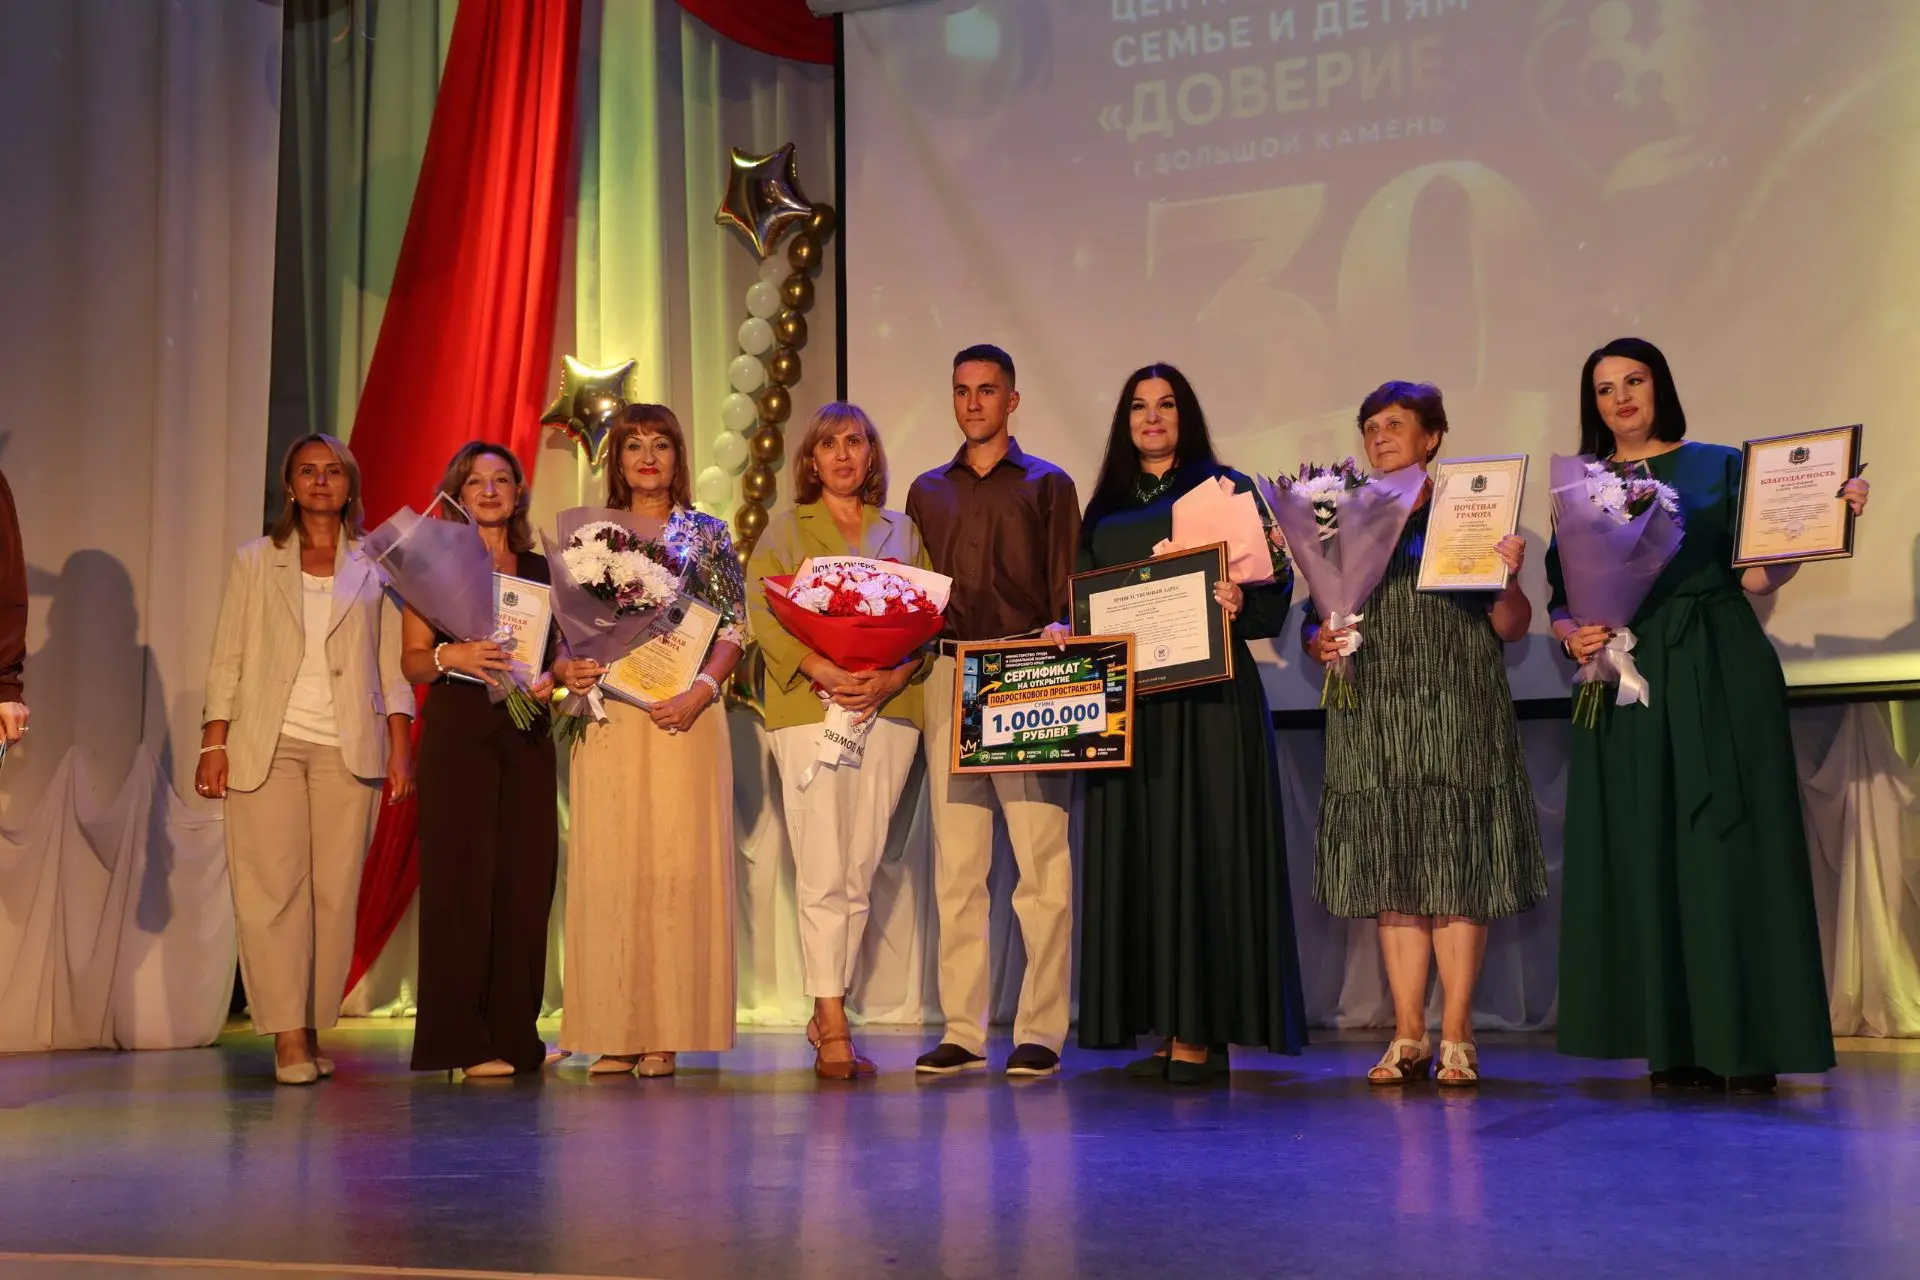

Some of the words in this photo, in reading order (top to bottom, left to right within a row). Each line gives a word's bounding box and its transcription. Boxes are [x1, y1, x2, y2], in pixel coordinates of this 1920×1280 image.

[1112, 16, 1253, 67] СЕМЬЕ
[1269, 9, 1295, 43] И
[1315, 114, 1448, 152] КАМЕНЬ
[1760, 470, 1836, 485] БЛАГОДАРНОСТЬ
[1454, 502, 1497, 511] ПОЧЁТНАЯ
[1456, 511, 1492, 519] ГРАМОТА
[833, 562, 877, 571] FOERS
[1004, 661, 1080, 684] СЕРТИФИКАТ
[1017, 682, 1028, 690] НА
[1030, 675, 1070, 689] ОТКРЫТИЕ
[990, 690, 1048, 704] ПОДРОСТКОВОГО
[1050, 682, 1101, 696] ПРОСТРАНСТВА
[992, 702, 1099, 733] 1.000.000
[1022, 725, 1069, 742] РУБЛЕЙ
